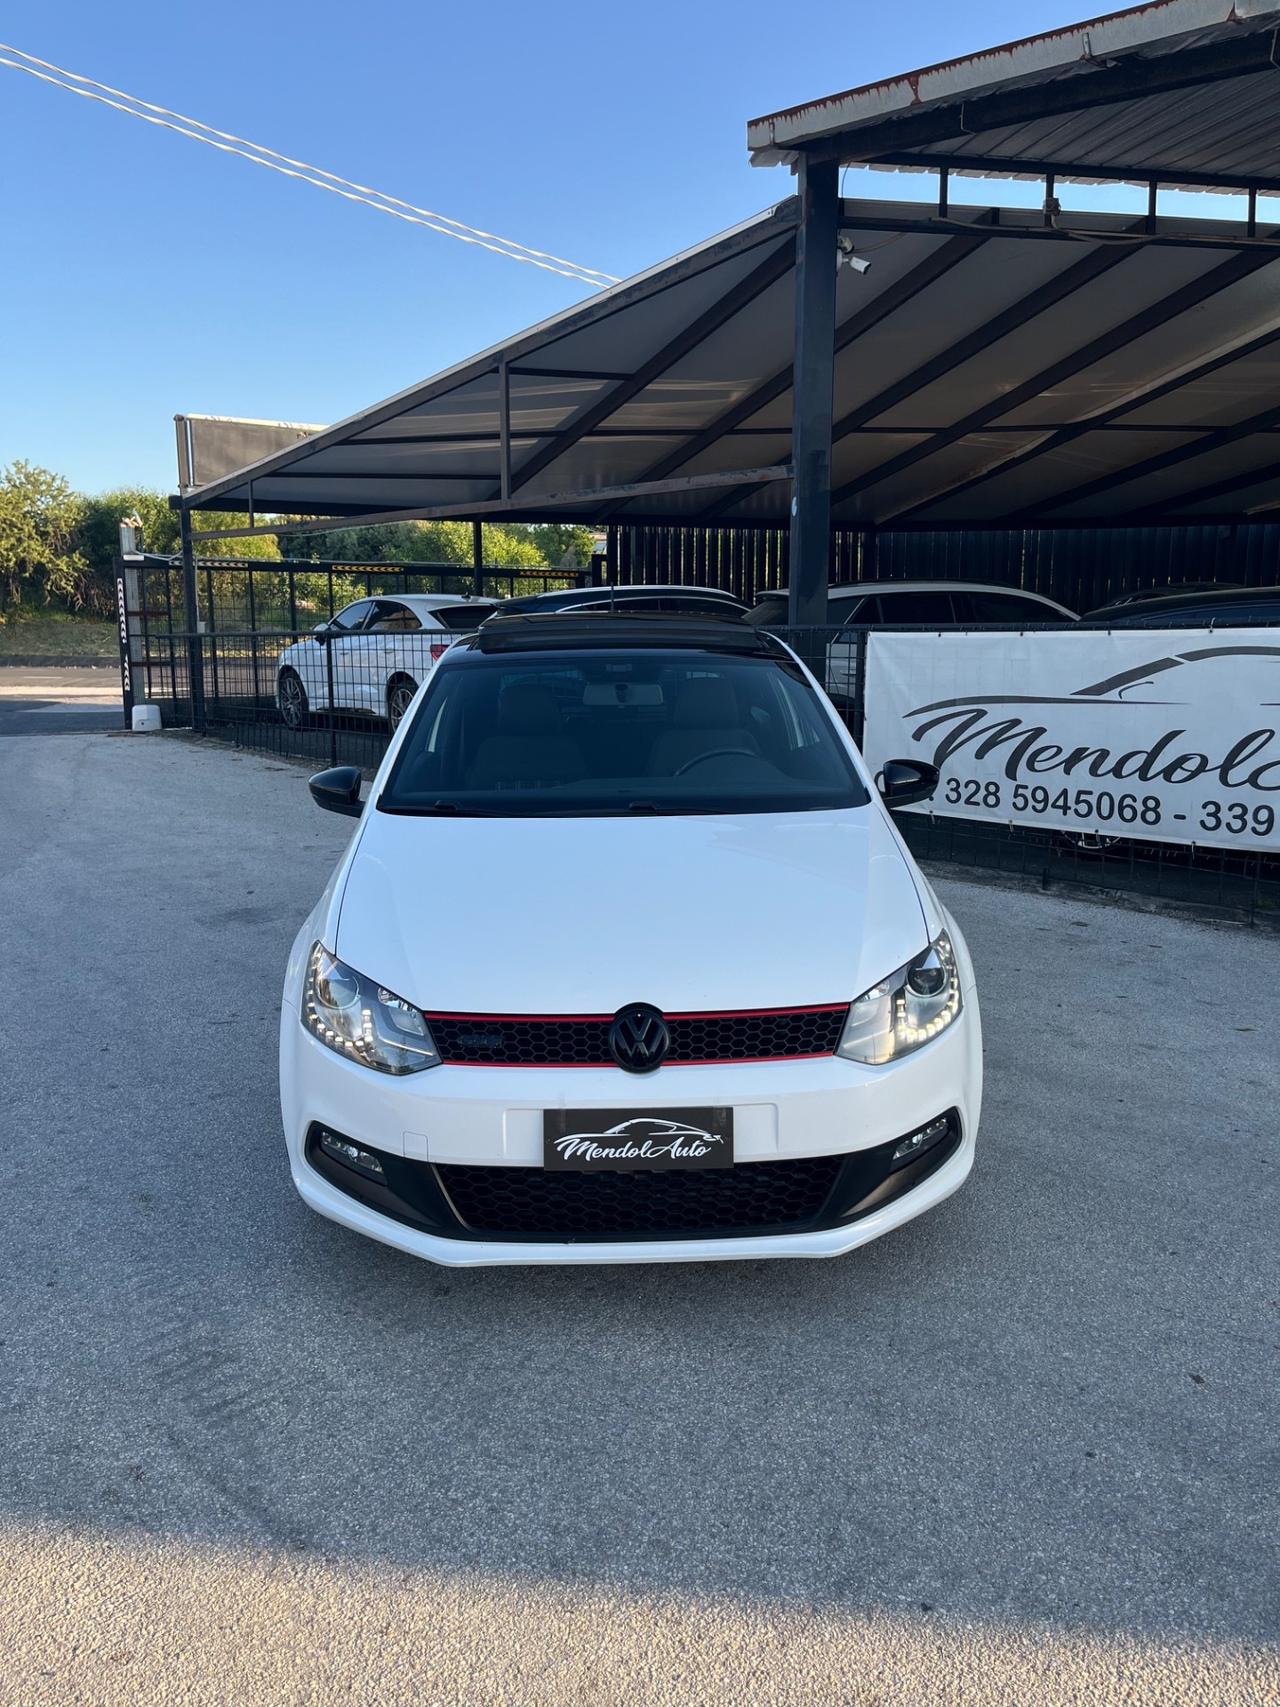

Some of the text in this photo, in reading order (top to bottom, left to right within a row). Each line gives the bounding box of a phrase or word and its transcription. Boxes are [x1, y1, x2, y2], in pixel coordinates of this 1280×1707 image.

[945, 778, 1001, 808] 328
[1012, 784, 1162, 826] 5945068
[1200, 800, 1275, 837] 339
[612, 1008, 667, 1066] VW
